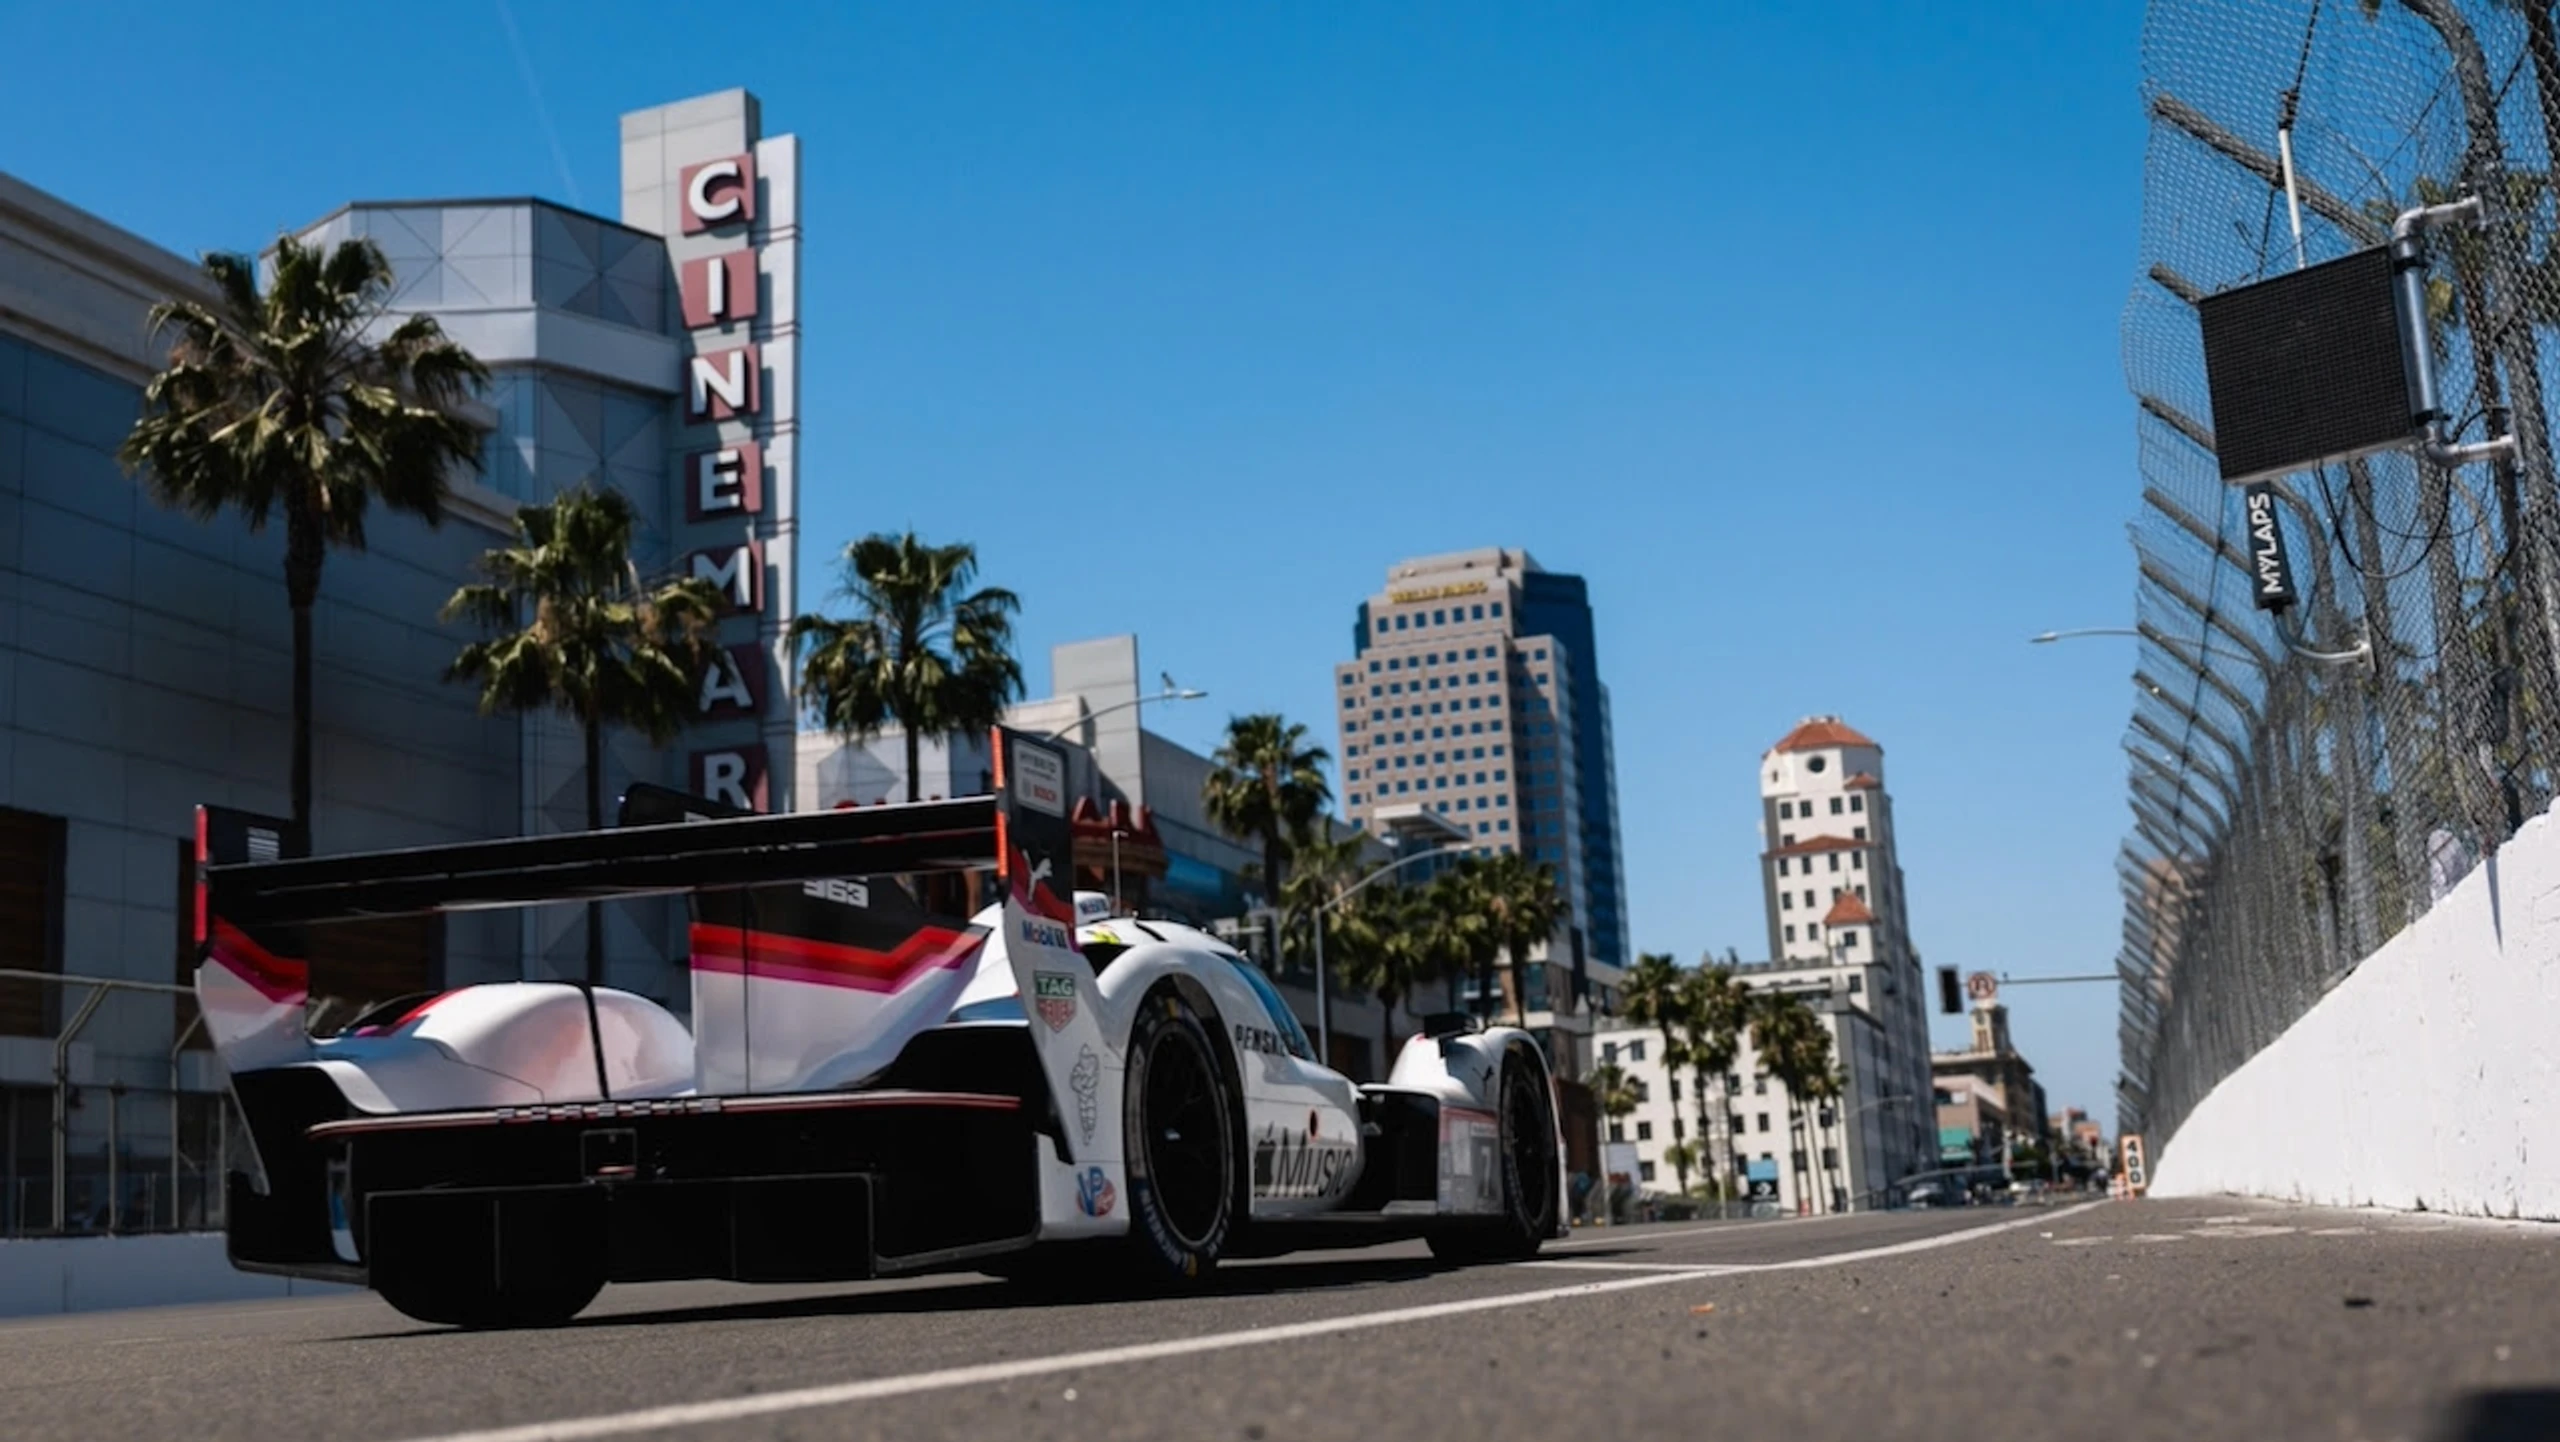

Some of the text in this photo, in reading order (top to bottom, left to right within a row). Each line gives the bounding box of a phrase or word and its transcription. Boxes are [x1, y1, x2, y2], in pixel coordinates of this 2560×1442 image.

[2249, 493, 2285, 594] MYLAPS
[1022, 919, 1055, 947] Mobil
[1038, 977, 1073, 995] TAG
[2128, 1140, 2142, 1184] 400
